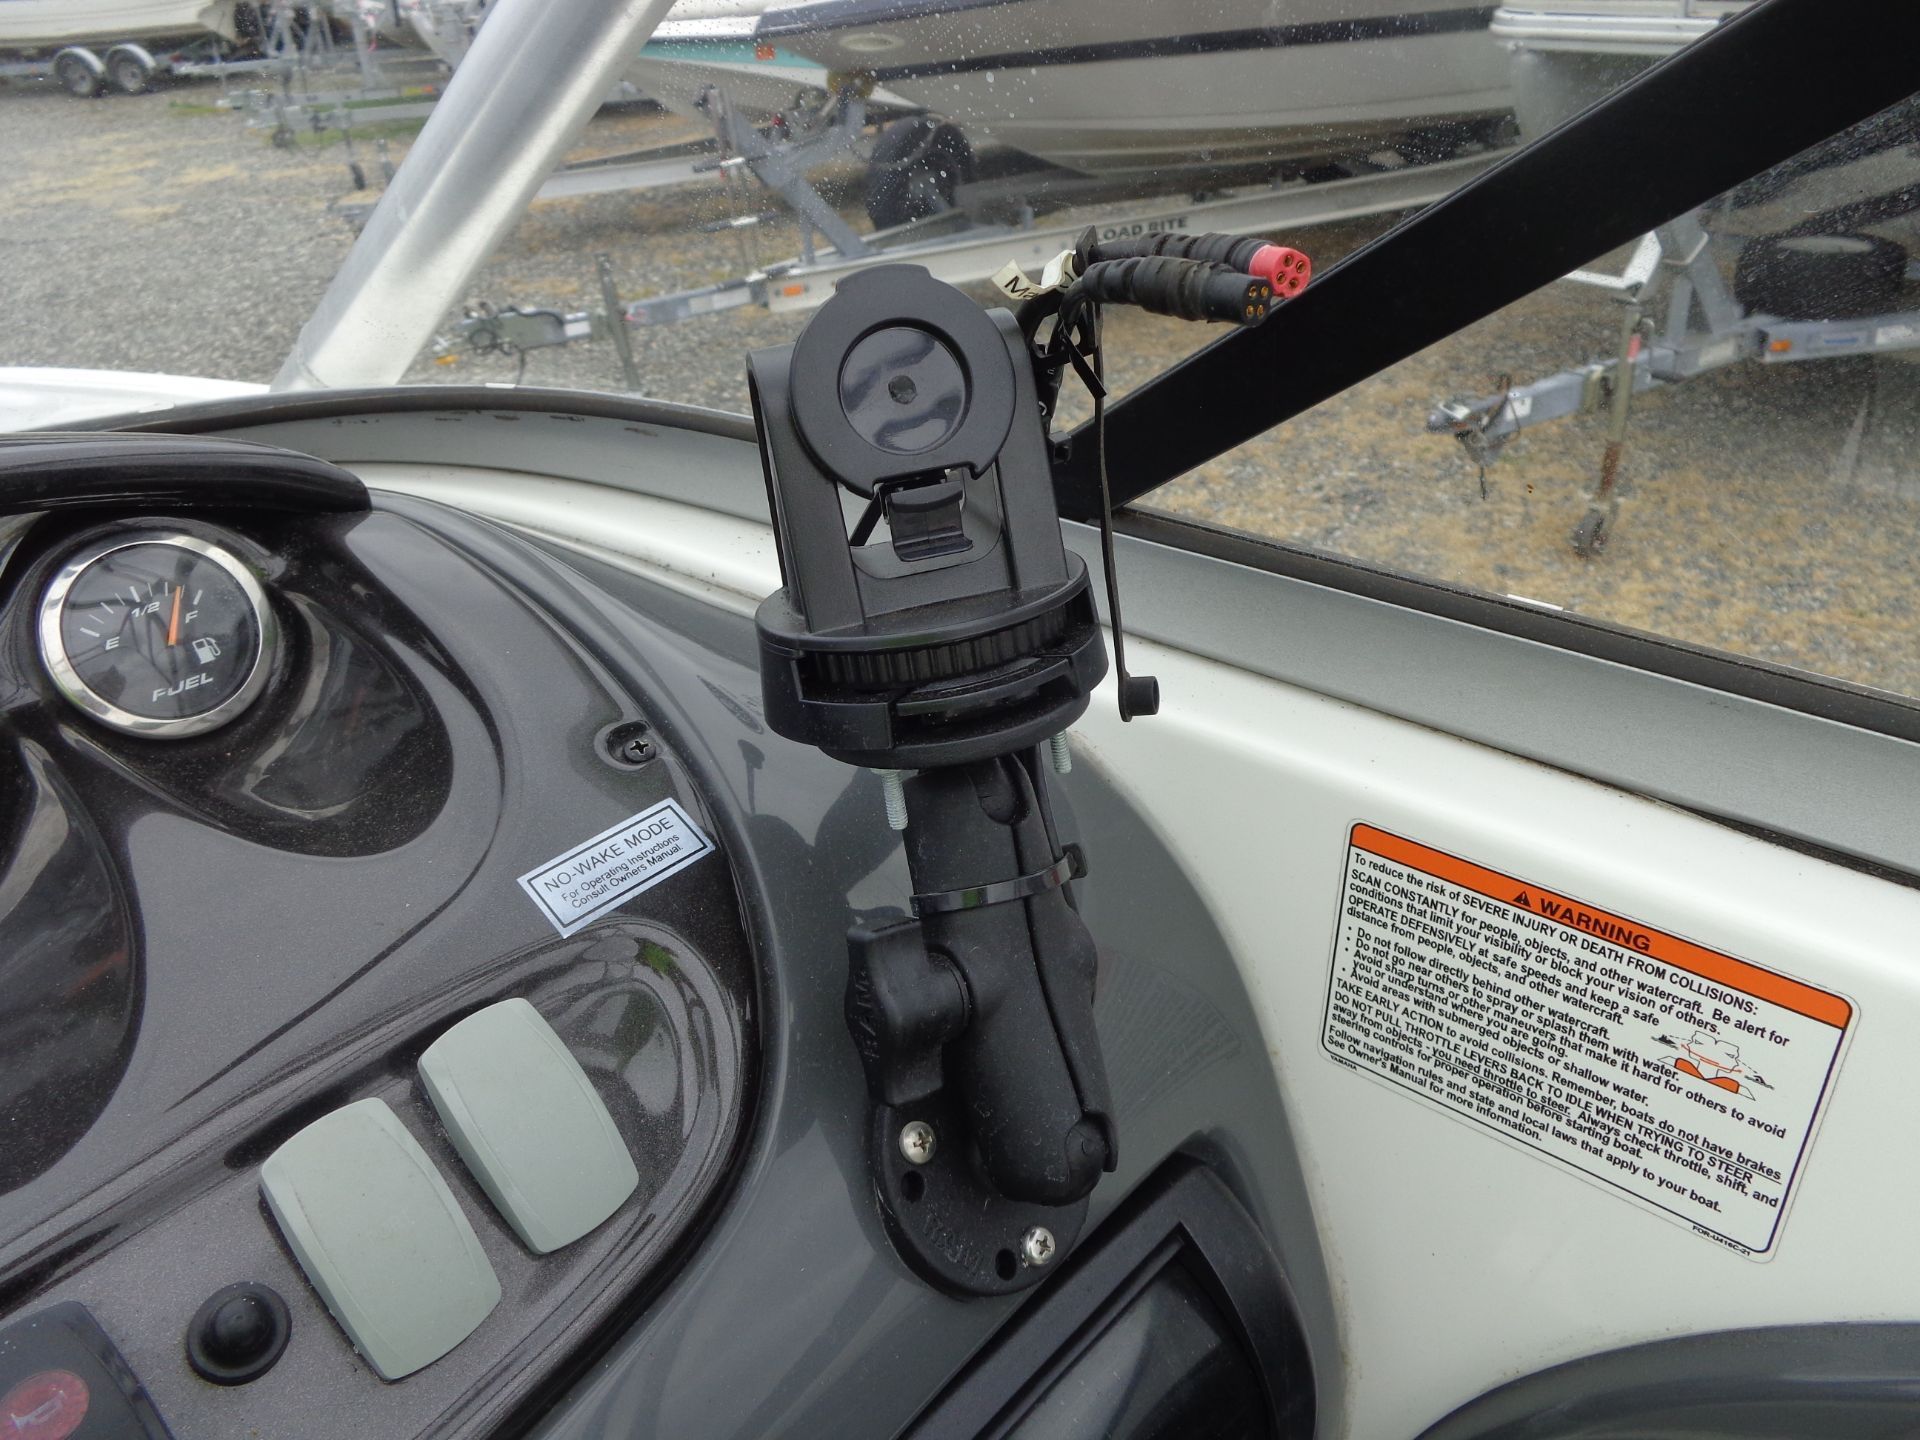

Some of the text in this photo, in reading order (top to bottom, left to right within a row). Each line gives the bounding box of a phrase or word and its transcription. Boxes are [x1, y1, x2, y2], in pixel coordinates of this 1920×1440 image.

[105, 636, 120, 650] E
[131, 600, 161, 617] 1/2
[185, 609, 199, 624] F
[152, 672, 214, 702] FUEL
[544, 817, 674, 891] NO-WAKE MODE
[561, 834, 680, 902] For Operating Instructions
[571, 845, 684, 909] Consult Owners Manual.
[1346, 905, 1624, 1025] distance from people, objects, and other watercraft.
[1348, 894, 1660, 1026] OPERATE DEFENSIVELY at safe speeds and keep safe
[1349, 882, 1720, 1035] conditions that limit your visibility or block your vision of others.
[1350, 868, 1790, 1047] SCAN CONSTANTLY for people, objects, and other watercraft. Be alert for
[1354, 852, 1758, 1015] To reduce the risk of SEVERE INJURY OR DEATH FROM COLLISIONS:
[1357, 926, 1610, 1040] Do not follow directly behind other watercraft.
[1540, 898, 1650, 952] WARNING
[1349, 968, 1648, 1106] Avoid areas with submerged objects or shallow water.
[1353, 948, 1787, 1139] Avoid sharp turns or other maneuvers that make it hard for others to avoid
[1355, 937, 1682, 1081] Do not go near others to spray or splash them with water.
[1327, 1034, 1542, 1141] See Owner's Manual for more information.
[1328, 1024, 1722, 1213] Follow navigation rules and state and local laws that apply to your boat.
[1334, 990, 1753, 1184] DO NOT PULL THROTTLE LEVERS BACK TO IDLE WHEN TRYING TO STEER
[1336, 976, 1781, 1180] TAKE EARLY ACTION to avoid collisions. Remember, boats do not have brakes
